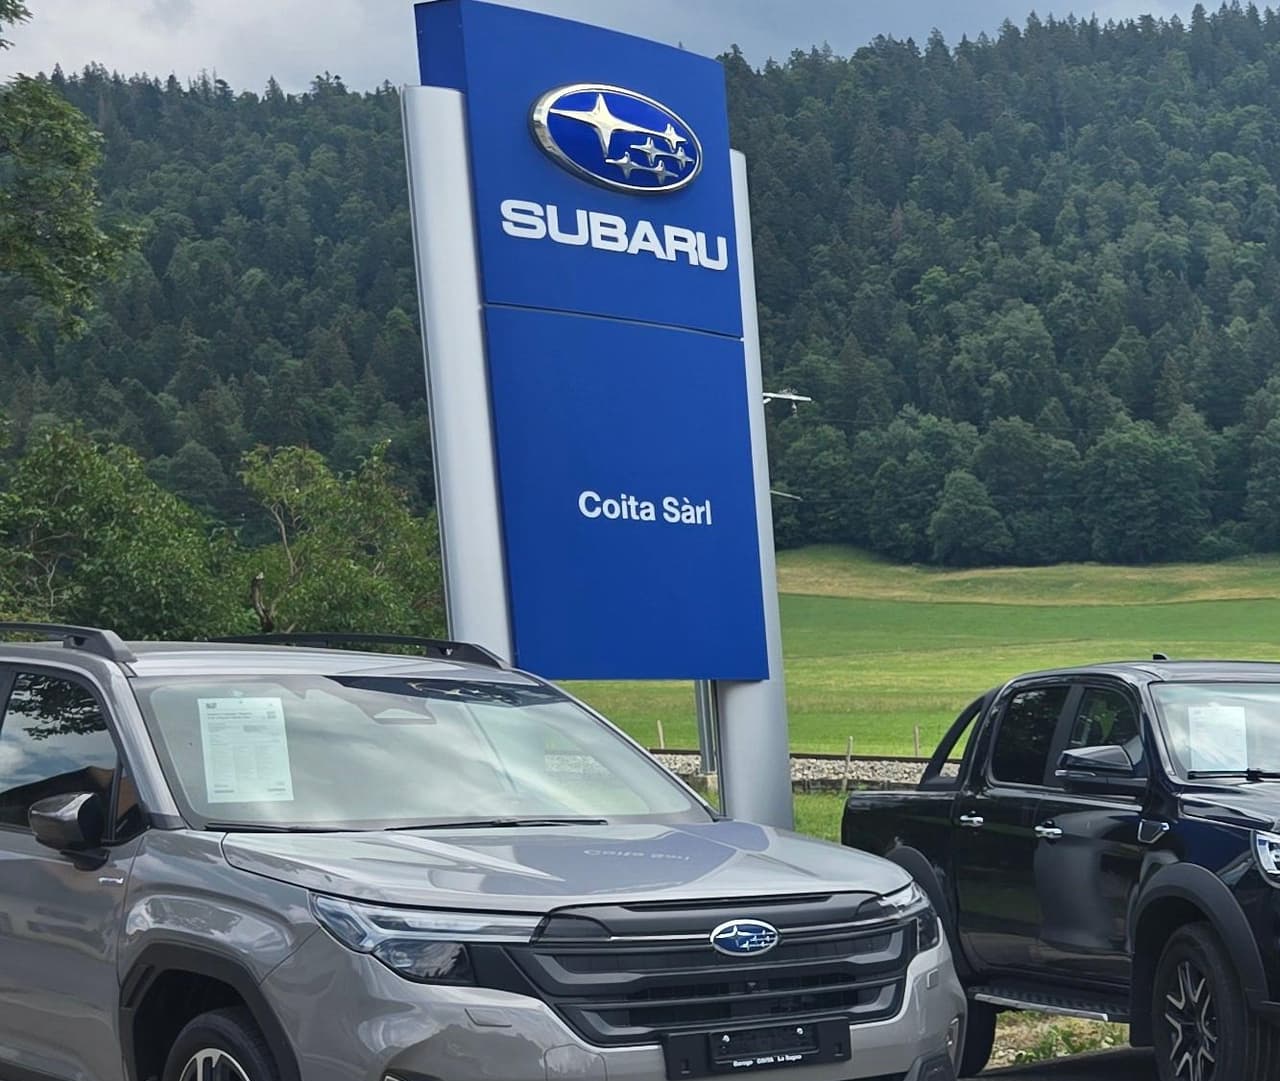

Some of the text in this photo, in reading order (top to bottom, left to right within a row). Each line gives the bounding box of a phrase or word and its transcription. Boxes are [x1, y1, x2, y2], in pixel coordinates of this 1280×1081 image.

[500, 199, 729, 271] SUBARU
[578, 490, 713, 525] Coita Sàrl
